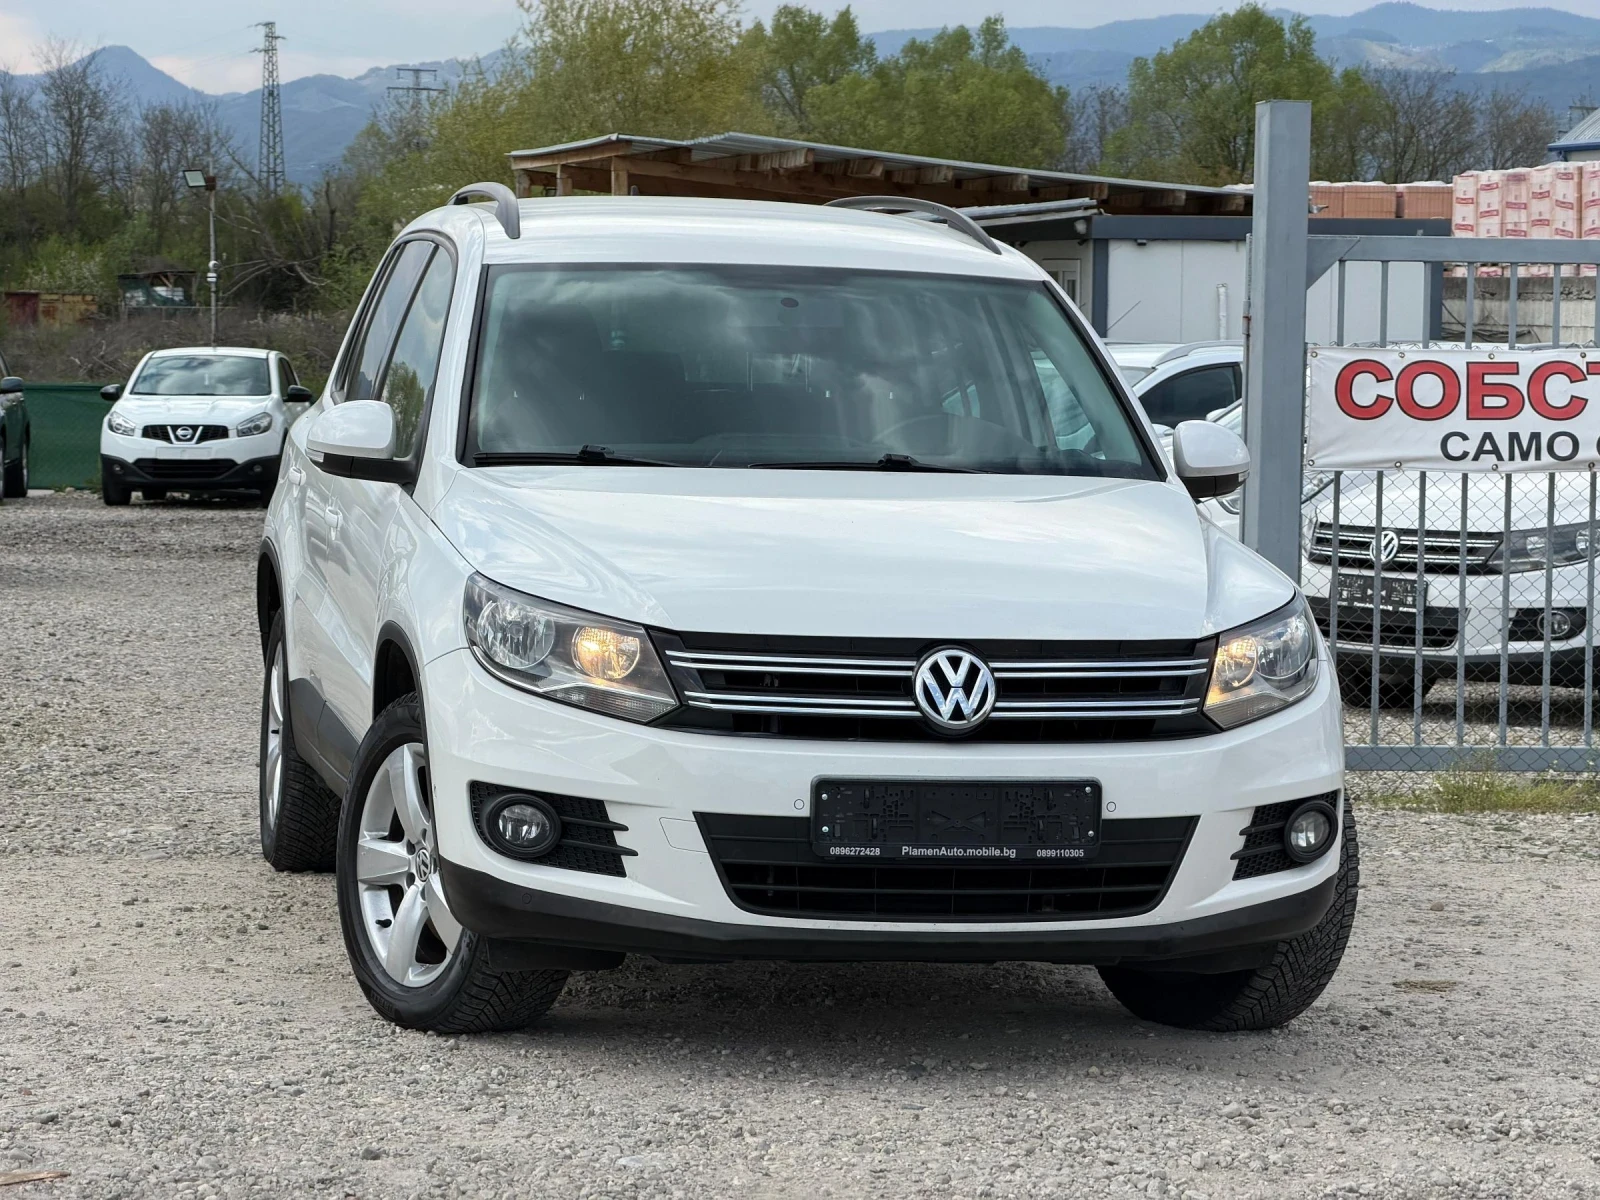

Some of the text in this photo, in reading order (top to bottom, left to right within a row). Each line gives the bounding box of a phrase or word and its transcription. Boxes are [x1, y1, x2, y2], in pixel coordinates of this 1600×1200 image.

[1335, 359, 1600, 421] СОБС
[1440, 431, 1580, 462] САМО
[829, 846, 881, 856] 0896272428
[901, 846, 1017, 858] PlamenAuto.mobile.bg
[1036, 849, 1085, 857] 0899110305
